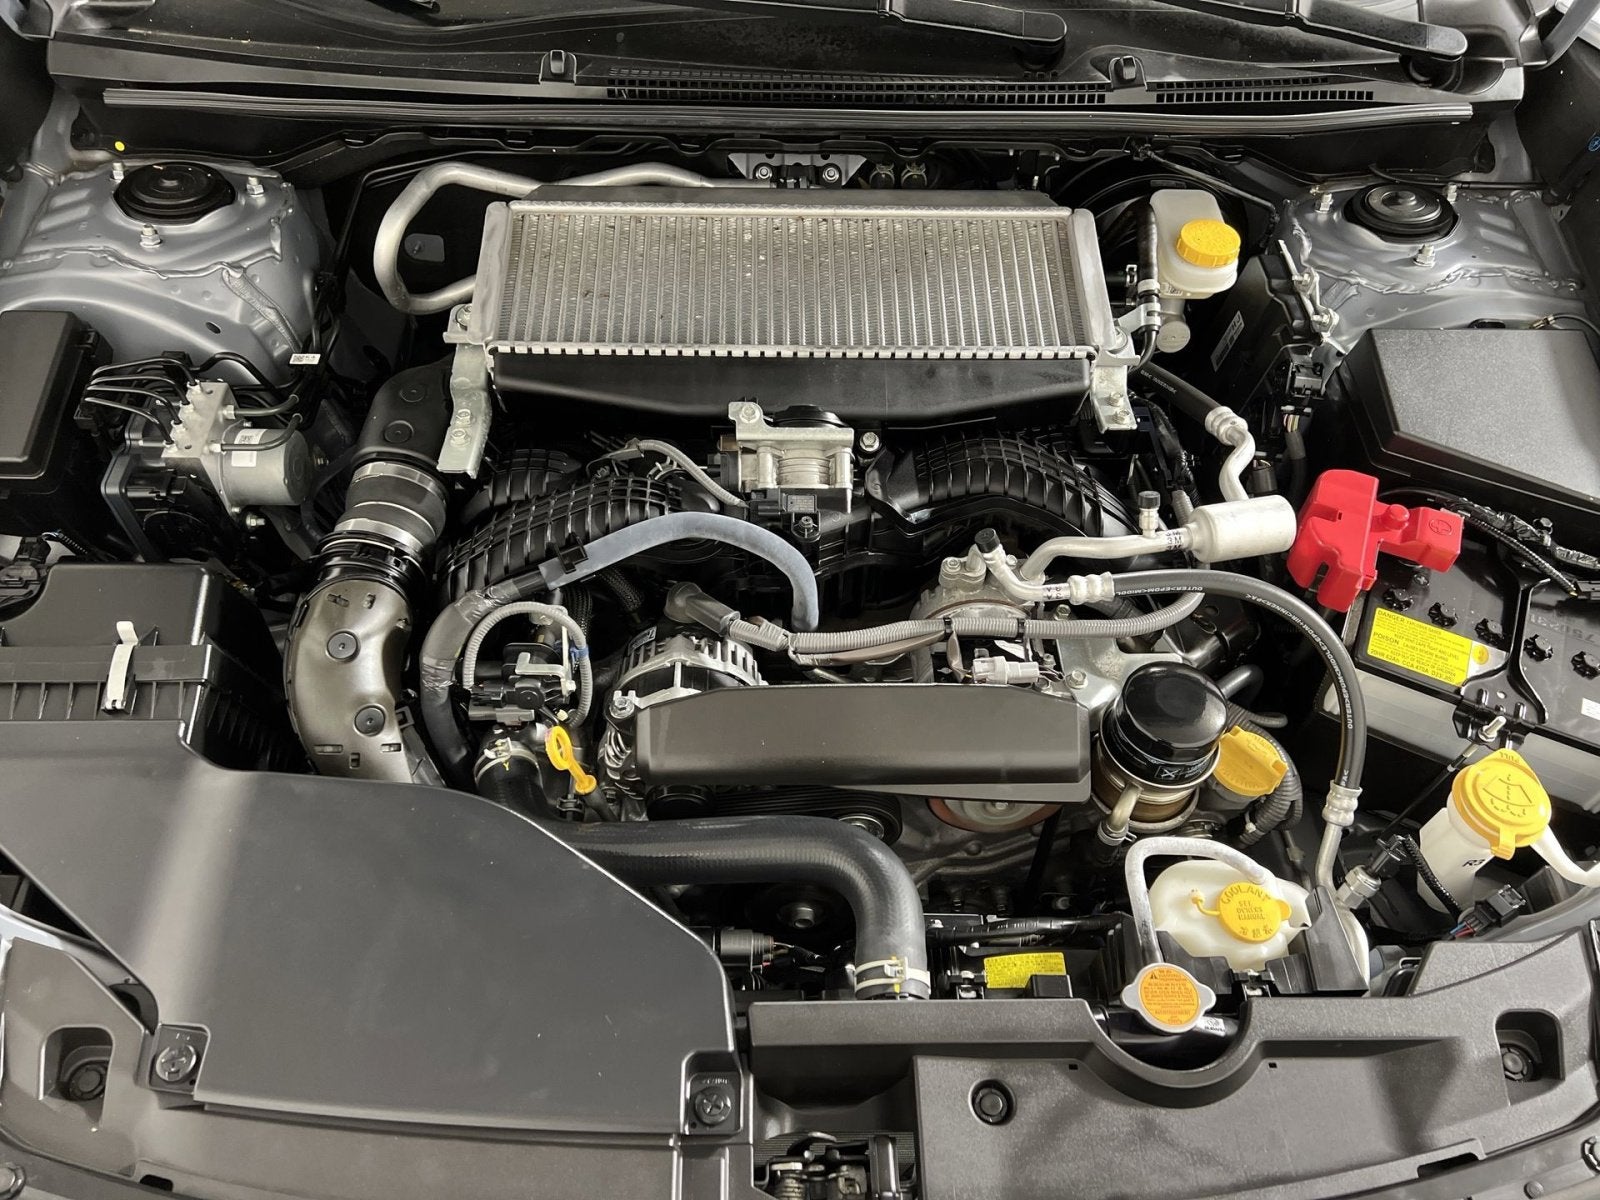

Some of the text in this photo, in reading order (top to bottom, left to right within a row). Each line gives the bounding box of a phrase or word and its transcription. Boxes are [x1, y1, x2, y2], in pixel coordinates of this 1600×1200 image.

[1377, 609, 1405, 623] DANGER
[1373, 631, 1399, 645] POISON
[1221, 884, 1271, 904] COOLANT
